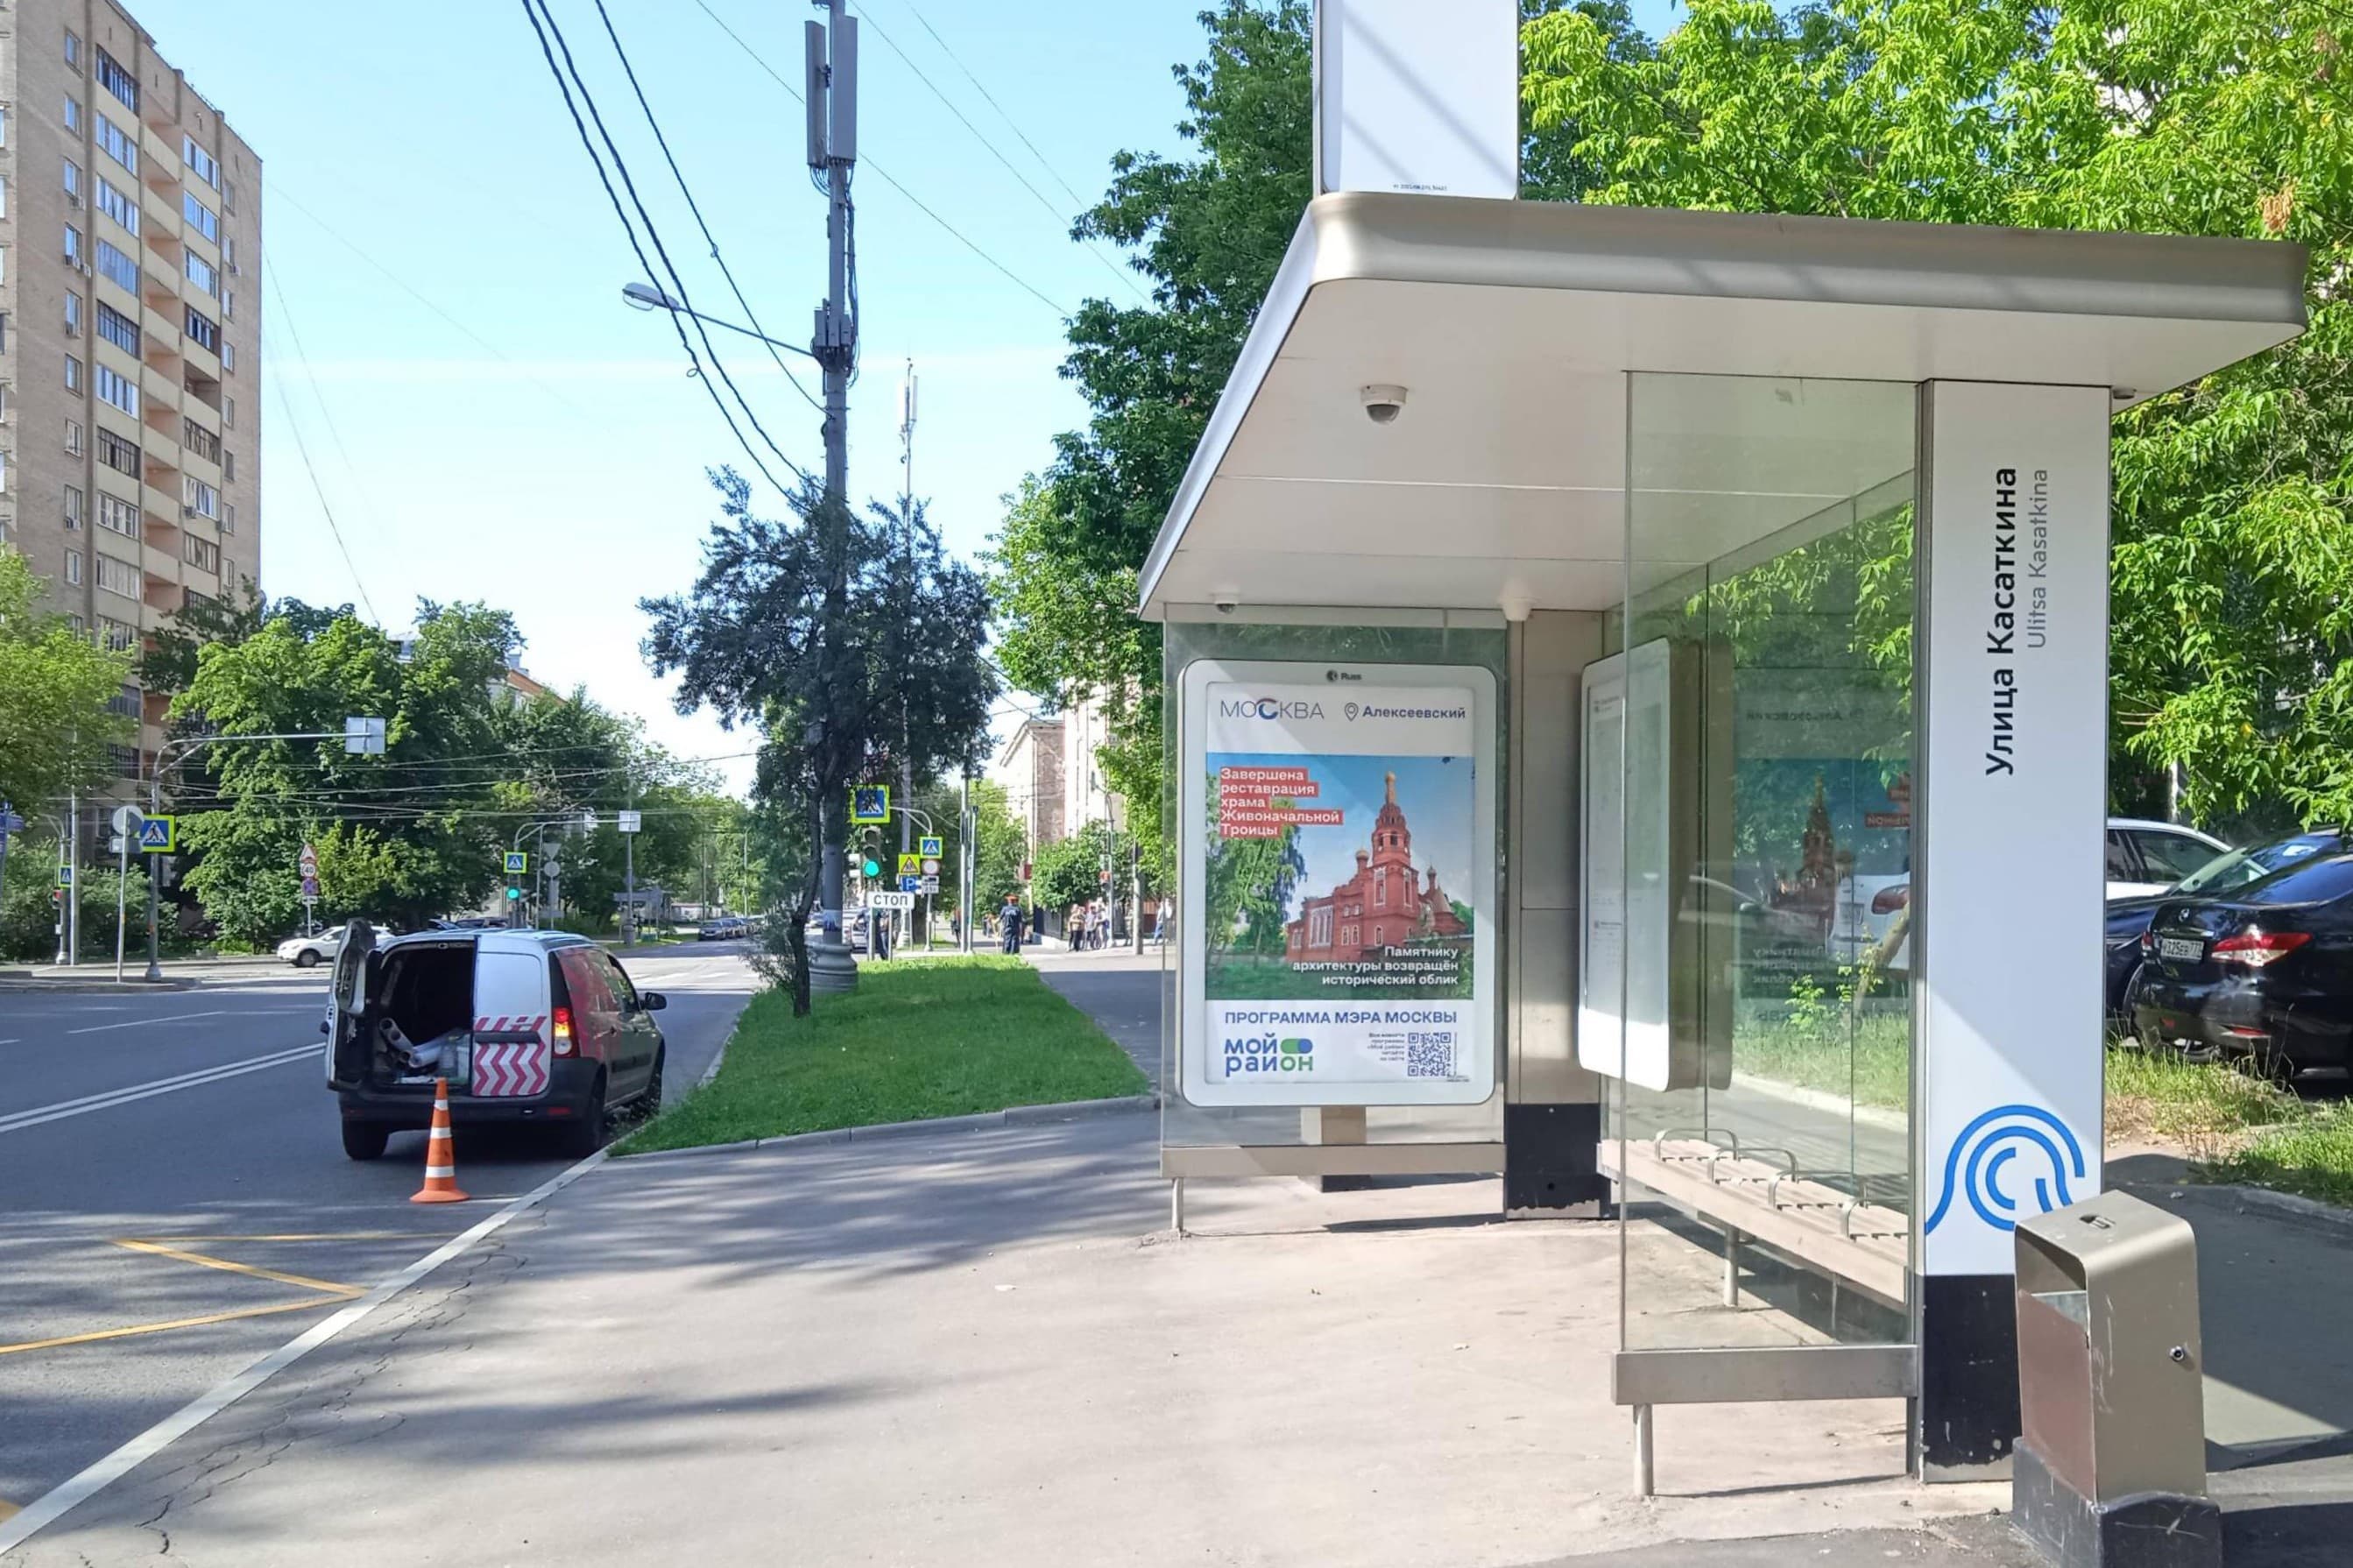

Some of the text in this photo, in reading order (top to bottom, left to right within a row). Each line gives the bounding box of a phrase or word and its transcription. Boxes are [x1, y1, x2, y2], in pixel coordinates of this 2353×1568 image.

[2027, 469, 2048, 648] Ulitsa Kasatkina
[1985, 467, 2018, 775] Улица Касаткина
[1219, 697, 1325, 721] МОСКВА
[1362, 704, 1466, 719] Алексеевский
[1221, 767, 1304, 782] Завершена
[1221, 783, 1315, 796] реставрация
[1221, 798, 1266, 809] храма
[1220, 809, 1339, 823] Живоначальной
[1221, 823, 1278, 837] Троицы
[873, 894, 908, 906] СТОП
[1384, 946, 1459, 959] Памятнику
[1293, 960, 1459, 973] архитектуры возвращён
[1322, 974, 1459, 986] исторический облик
[1225, 1011, 1457, 1024] ПРОГРАММА МЭРА МОСКВЫ
[1224, 1032, 1278, 1055] мой
